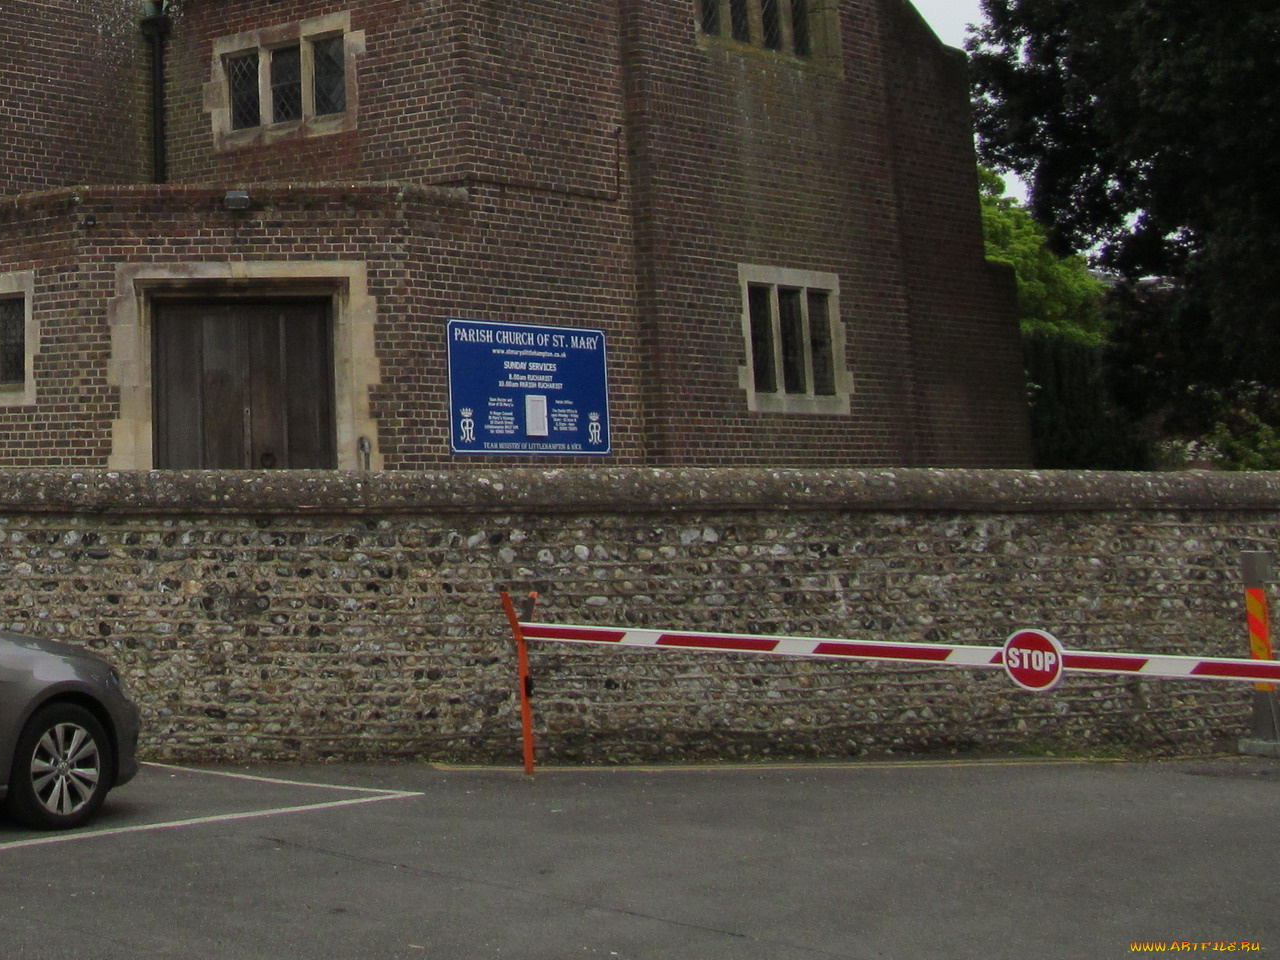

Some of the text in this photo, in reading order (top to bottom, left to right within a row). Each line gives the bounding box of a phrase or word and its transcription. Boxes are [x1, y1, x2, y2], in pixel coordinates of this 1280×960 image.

[454, 327, 599, 350] PARISH CHURCH OF ST. MARY
[503, 361, 557, 372] SUNDAY SERVICES
[527, 374, 553, 382] EUCHARIST
[519, 381, 537, 389] PARISH
[537, 382, 563, 390] EUCHARIST
[1008, 647, 1056, 672] STOP
